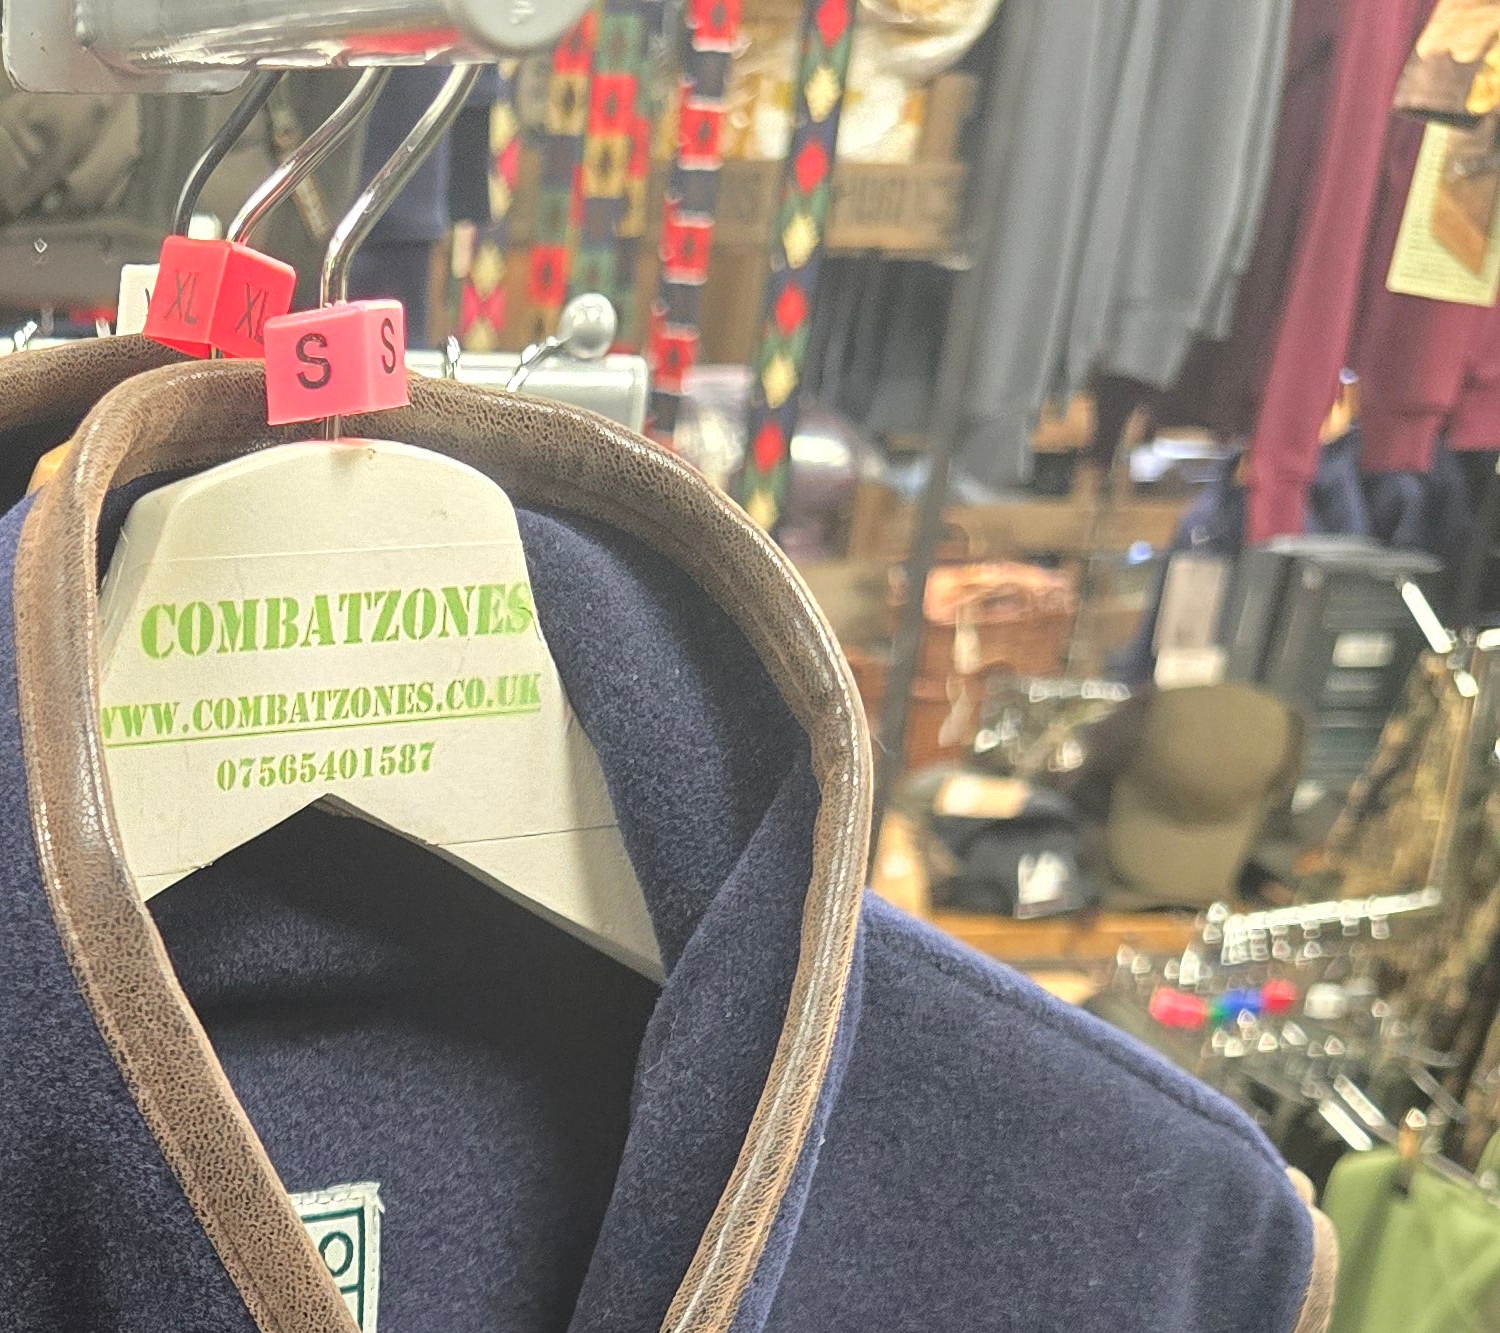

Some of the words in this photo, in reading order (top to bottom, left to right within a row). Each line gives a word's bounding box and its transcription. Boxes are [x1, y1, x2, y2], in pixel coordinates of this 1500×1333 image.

[164, 269, 197, 325] XL
[235, 282, 266, 345] XL
[296, 333, 331, 389] S
[381, 318, 396, 374] S
[140, 582, 535, 660] COMBATZONES
[216, 742, 437, 792] 07565401587
